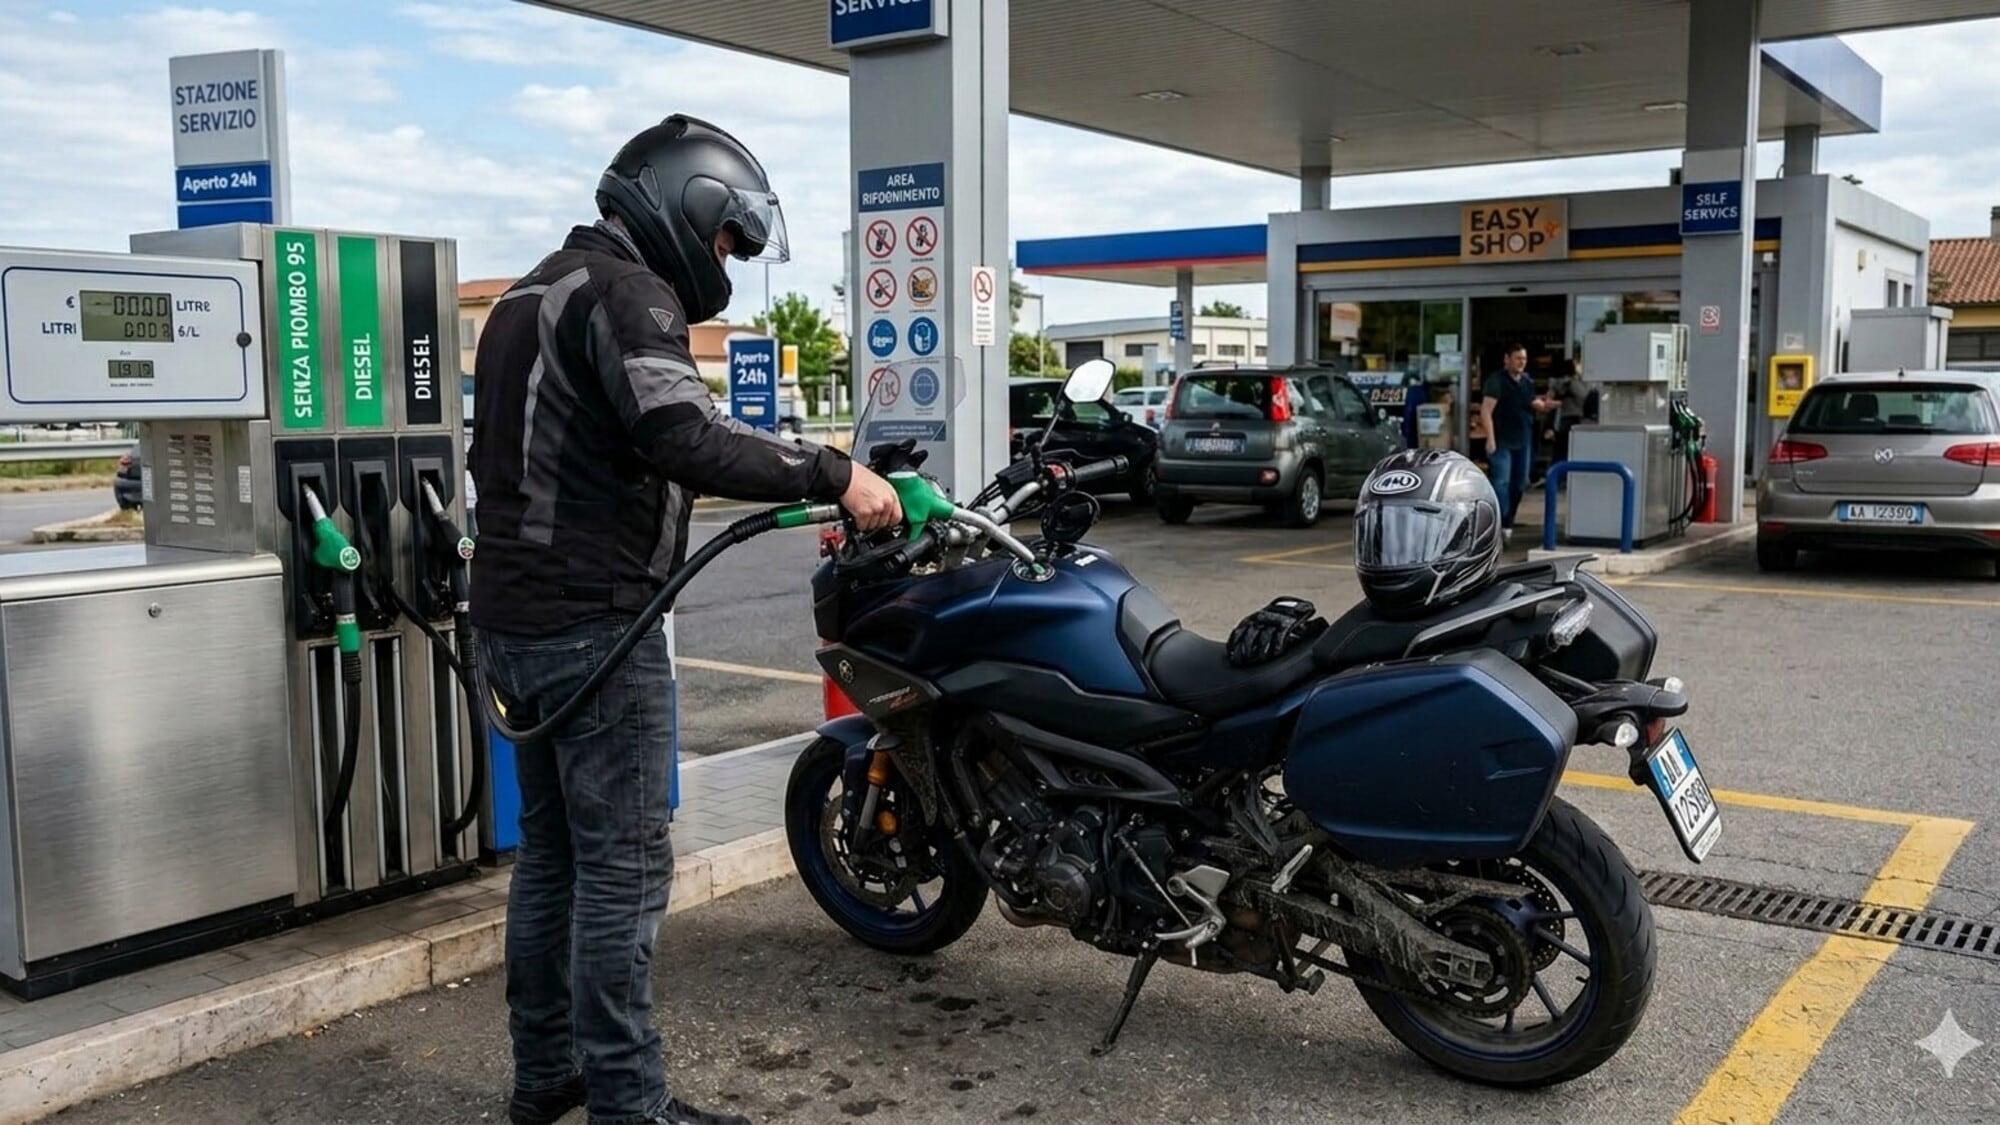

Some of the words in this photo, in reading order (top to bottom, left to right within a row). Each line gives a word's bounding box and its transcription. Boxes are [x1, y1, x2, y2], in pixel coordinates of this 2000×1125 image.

[175, 80, 258, 106] STAZIONE
[180, 108, 257, 133] SERVIZIO
[183, 175, 228, 194] Aperto
[230, 171, 257, 188] 24h
[886, 173, 915, 187] AREA
[1471, 207, 1539, 232] EASY
[287, 241, 306, 265] 95
[1469, 232, 1545, 255] SHOP
[288, 271, 309, 349] PIOMBO
[353, 333, 373, 400] DIESEL
[413, 334, 432, 399] DIESEL
[737, 368, 767, 386] 24h
[293, 355, 312, 418] SENZA
